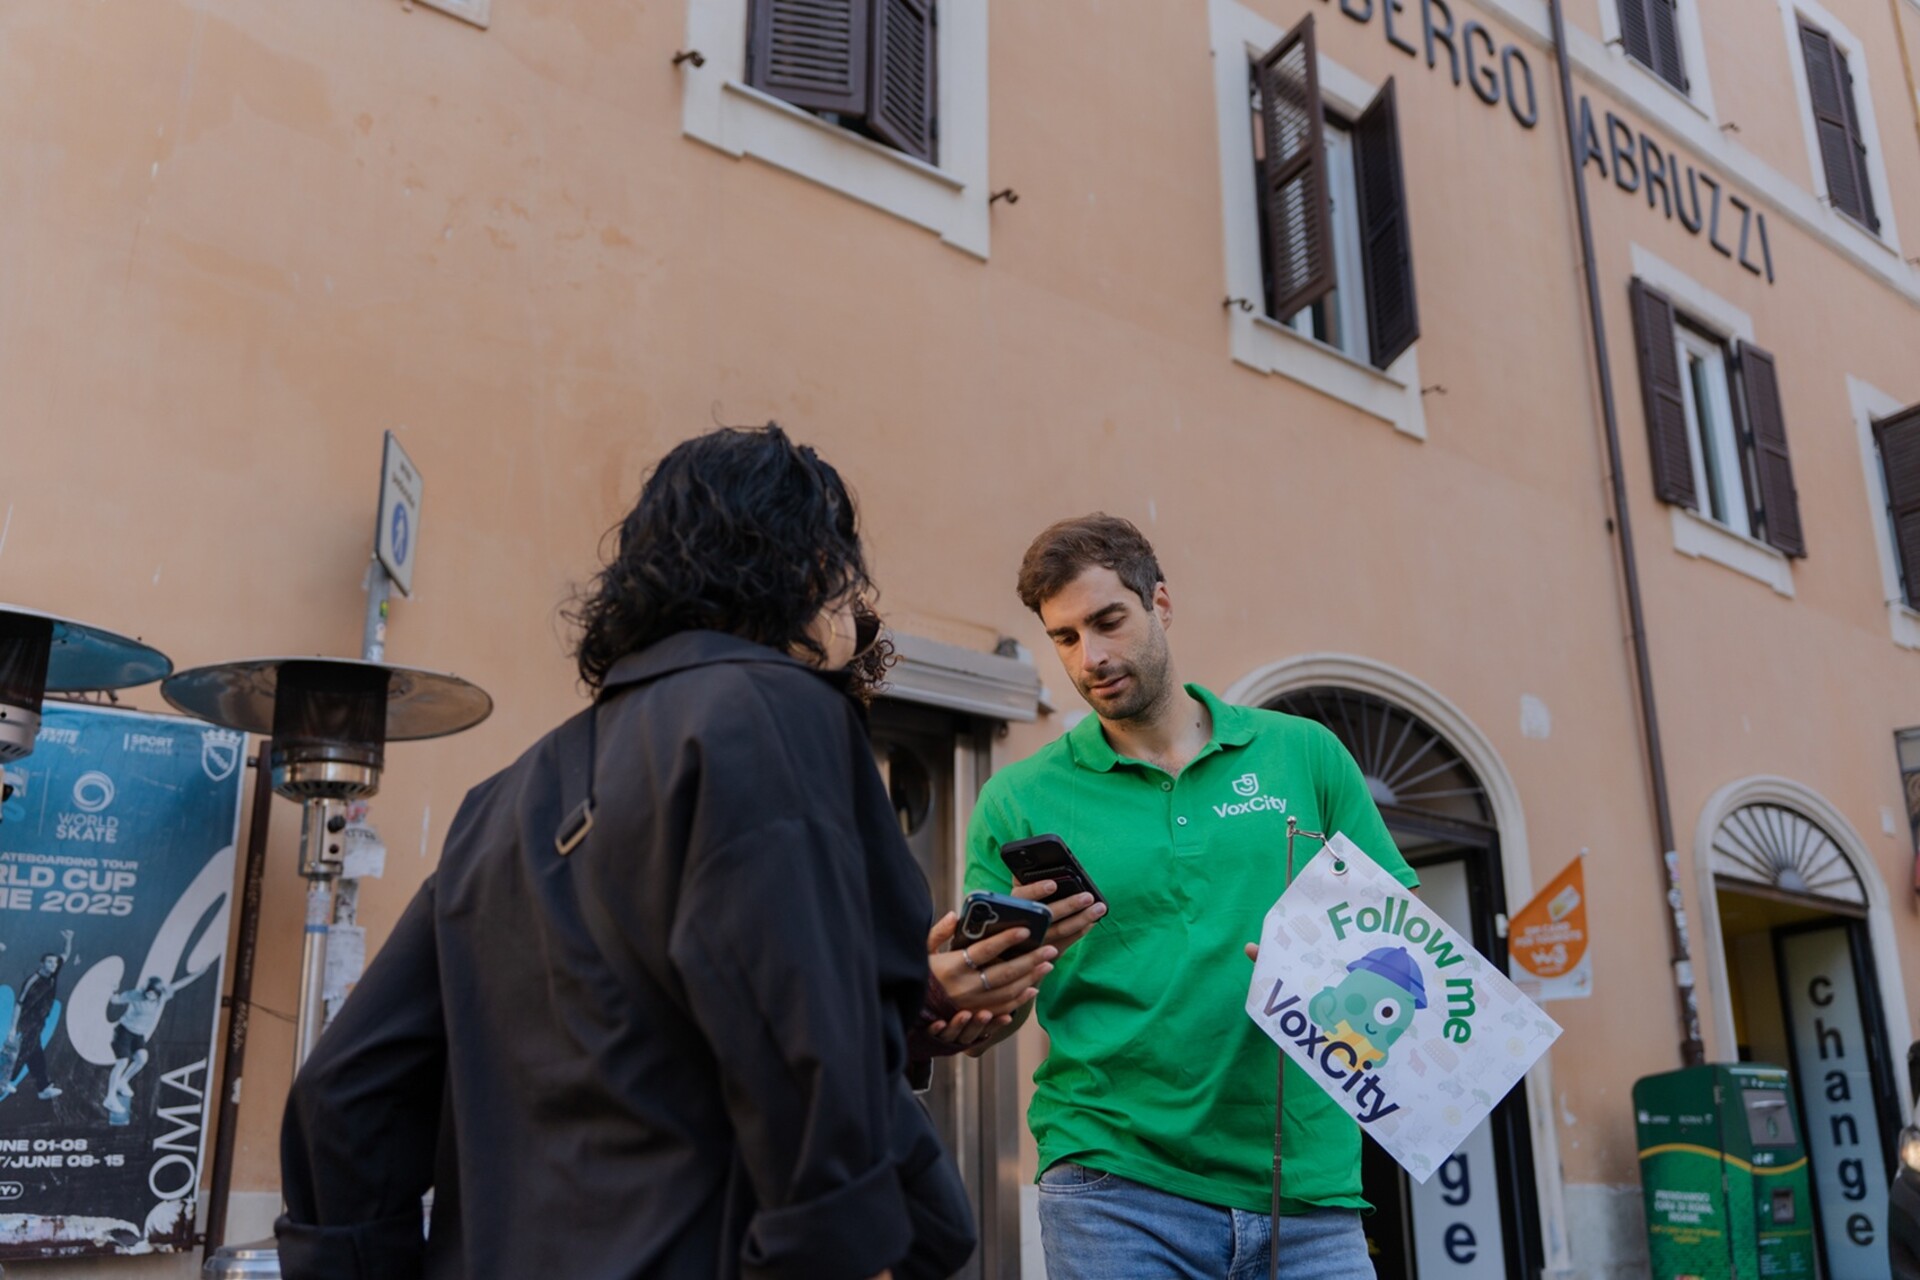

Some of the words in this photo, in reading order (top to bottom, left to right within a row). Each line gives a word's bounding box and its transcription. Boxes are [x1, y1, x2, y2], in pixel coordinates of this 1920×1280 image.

[1319, 0, 1537, 128] ERGO
[1578, 96, 1775, 284] ABRUZZI
[1212, 795, 1287, 818] VoxCity
[58, 812, 119, 829] WORLD
[56, 825, 118, 843] SKATE
[0, 852, 98, 868] ATEBOARDING
[102, 859, 138, 870] TOUR
[63, 868, 136, 892] CUP
[40, 890, 134, 916] 2025
[1327, 896, 1465, 969] Follow
[1443, 978, 1476, 1044] me
[1263, 978, 1400, 1123] VoxCity
[1808, 975, 1875, 1246] change
[149, 1057, 207, 1200] OMA
[33, 1139, 88, 1152] 01-08
[1438, 1153, 1477, 1265] ge
